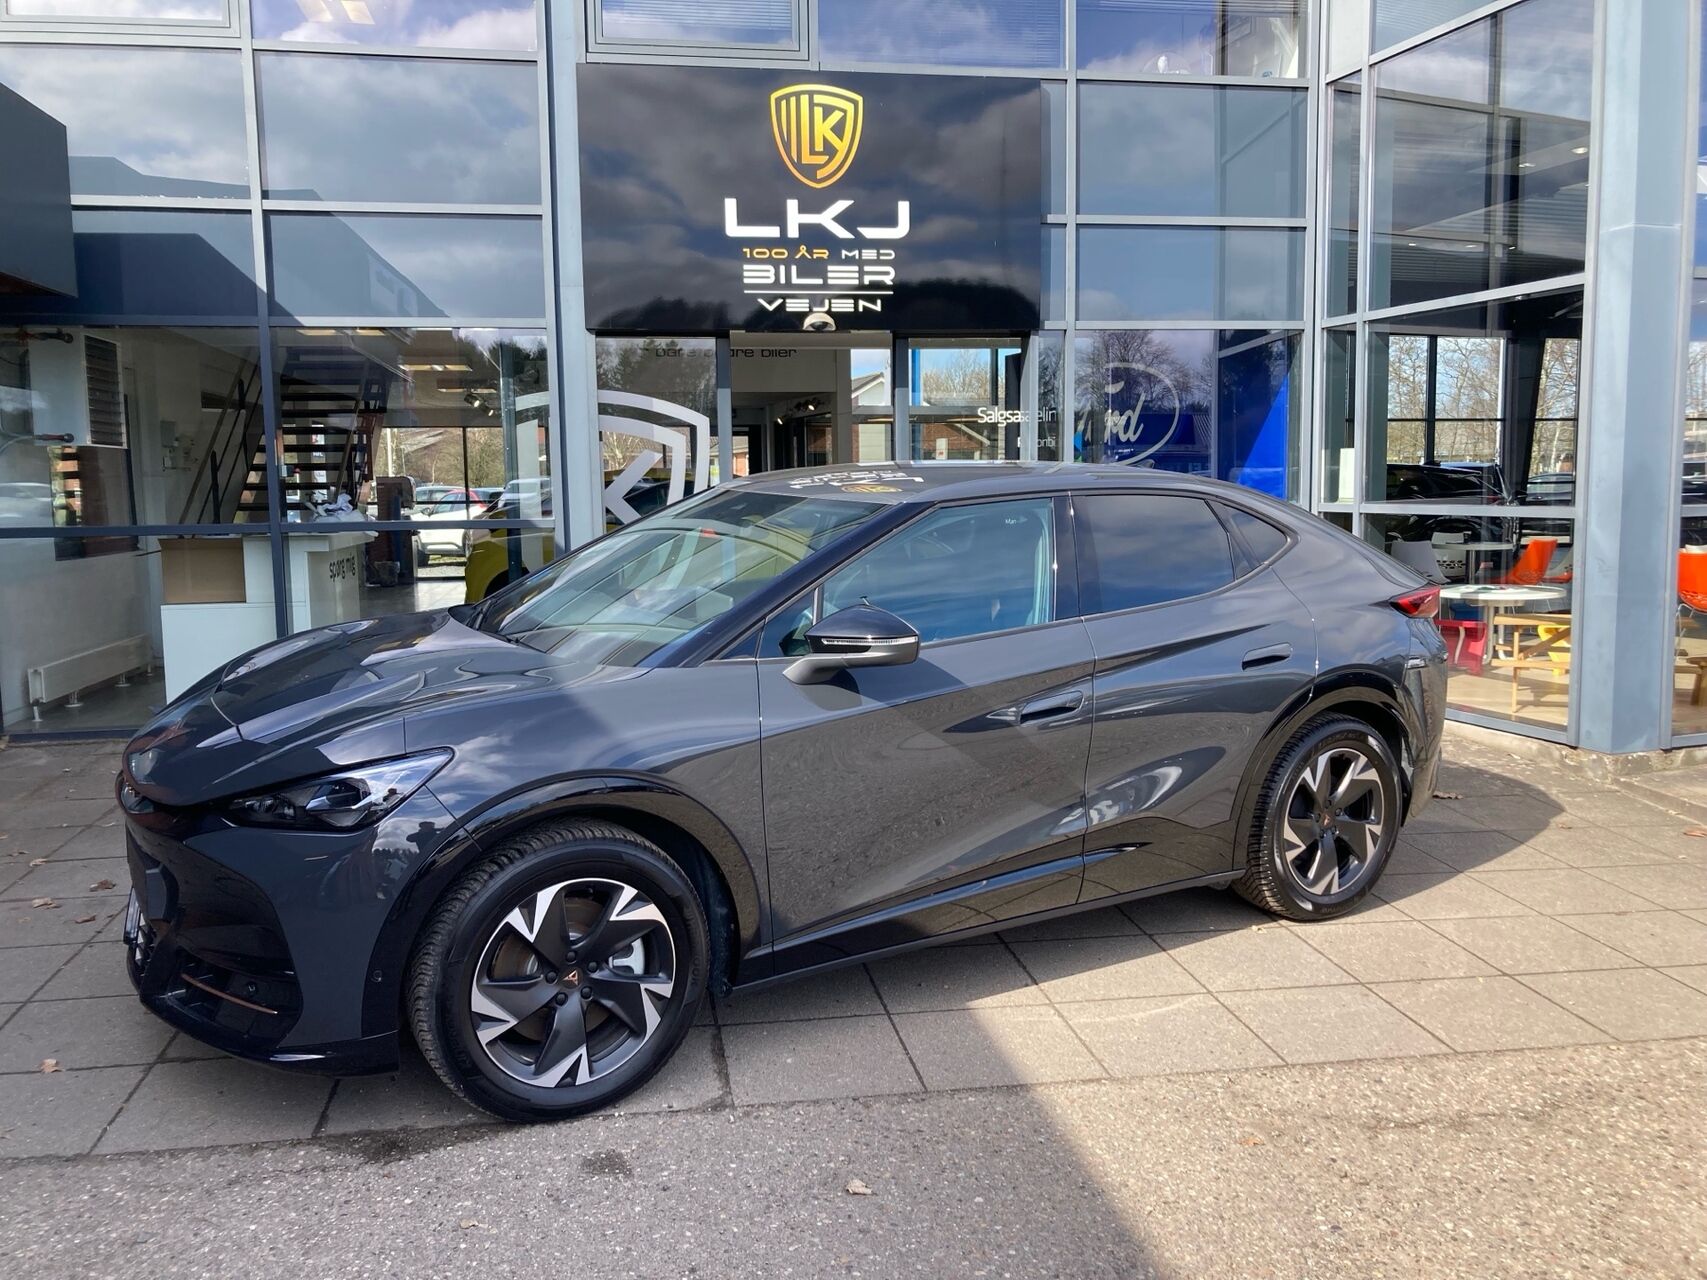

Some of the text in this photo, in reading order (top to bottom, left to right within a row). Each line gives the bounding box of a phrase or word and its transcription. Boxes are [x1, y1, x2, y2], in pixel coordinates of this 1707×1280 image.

[724, 197, 910, 239] LKJ
[743, 245, 896, 260] 100 ÅR MED
[743, 264, 896, 285] BILER
[757, 298, 882, 312] VEJEN
